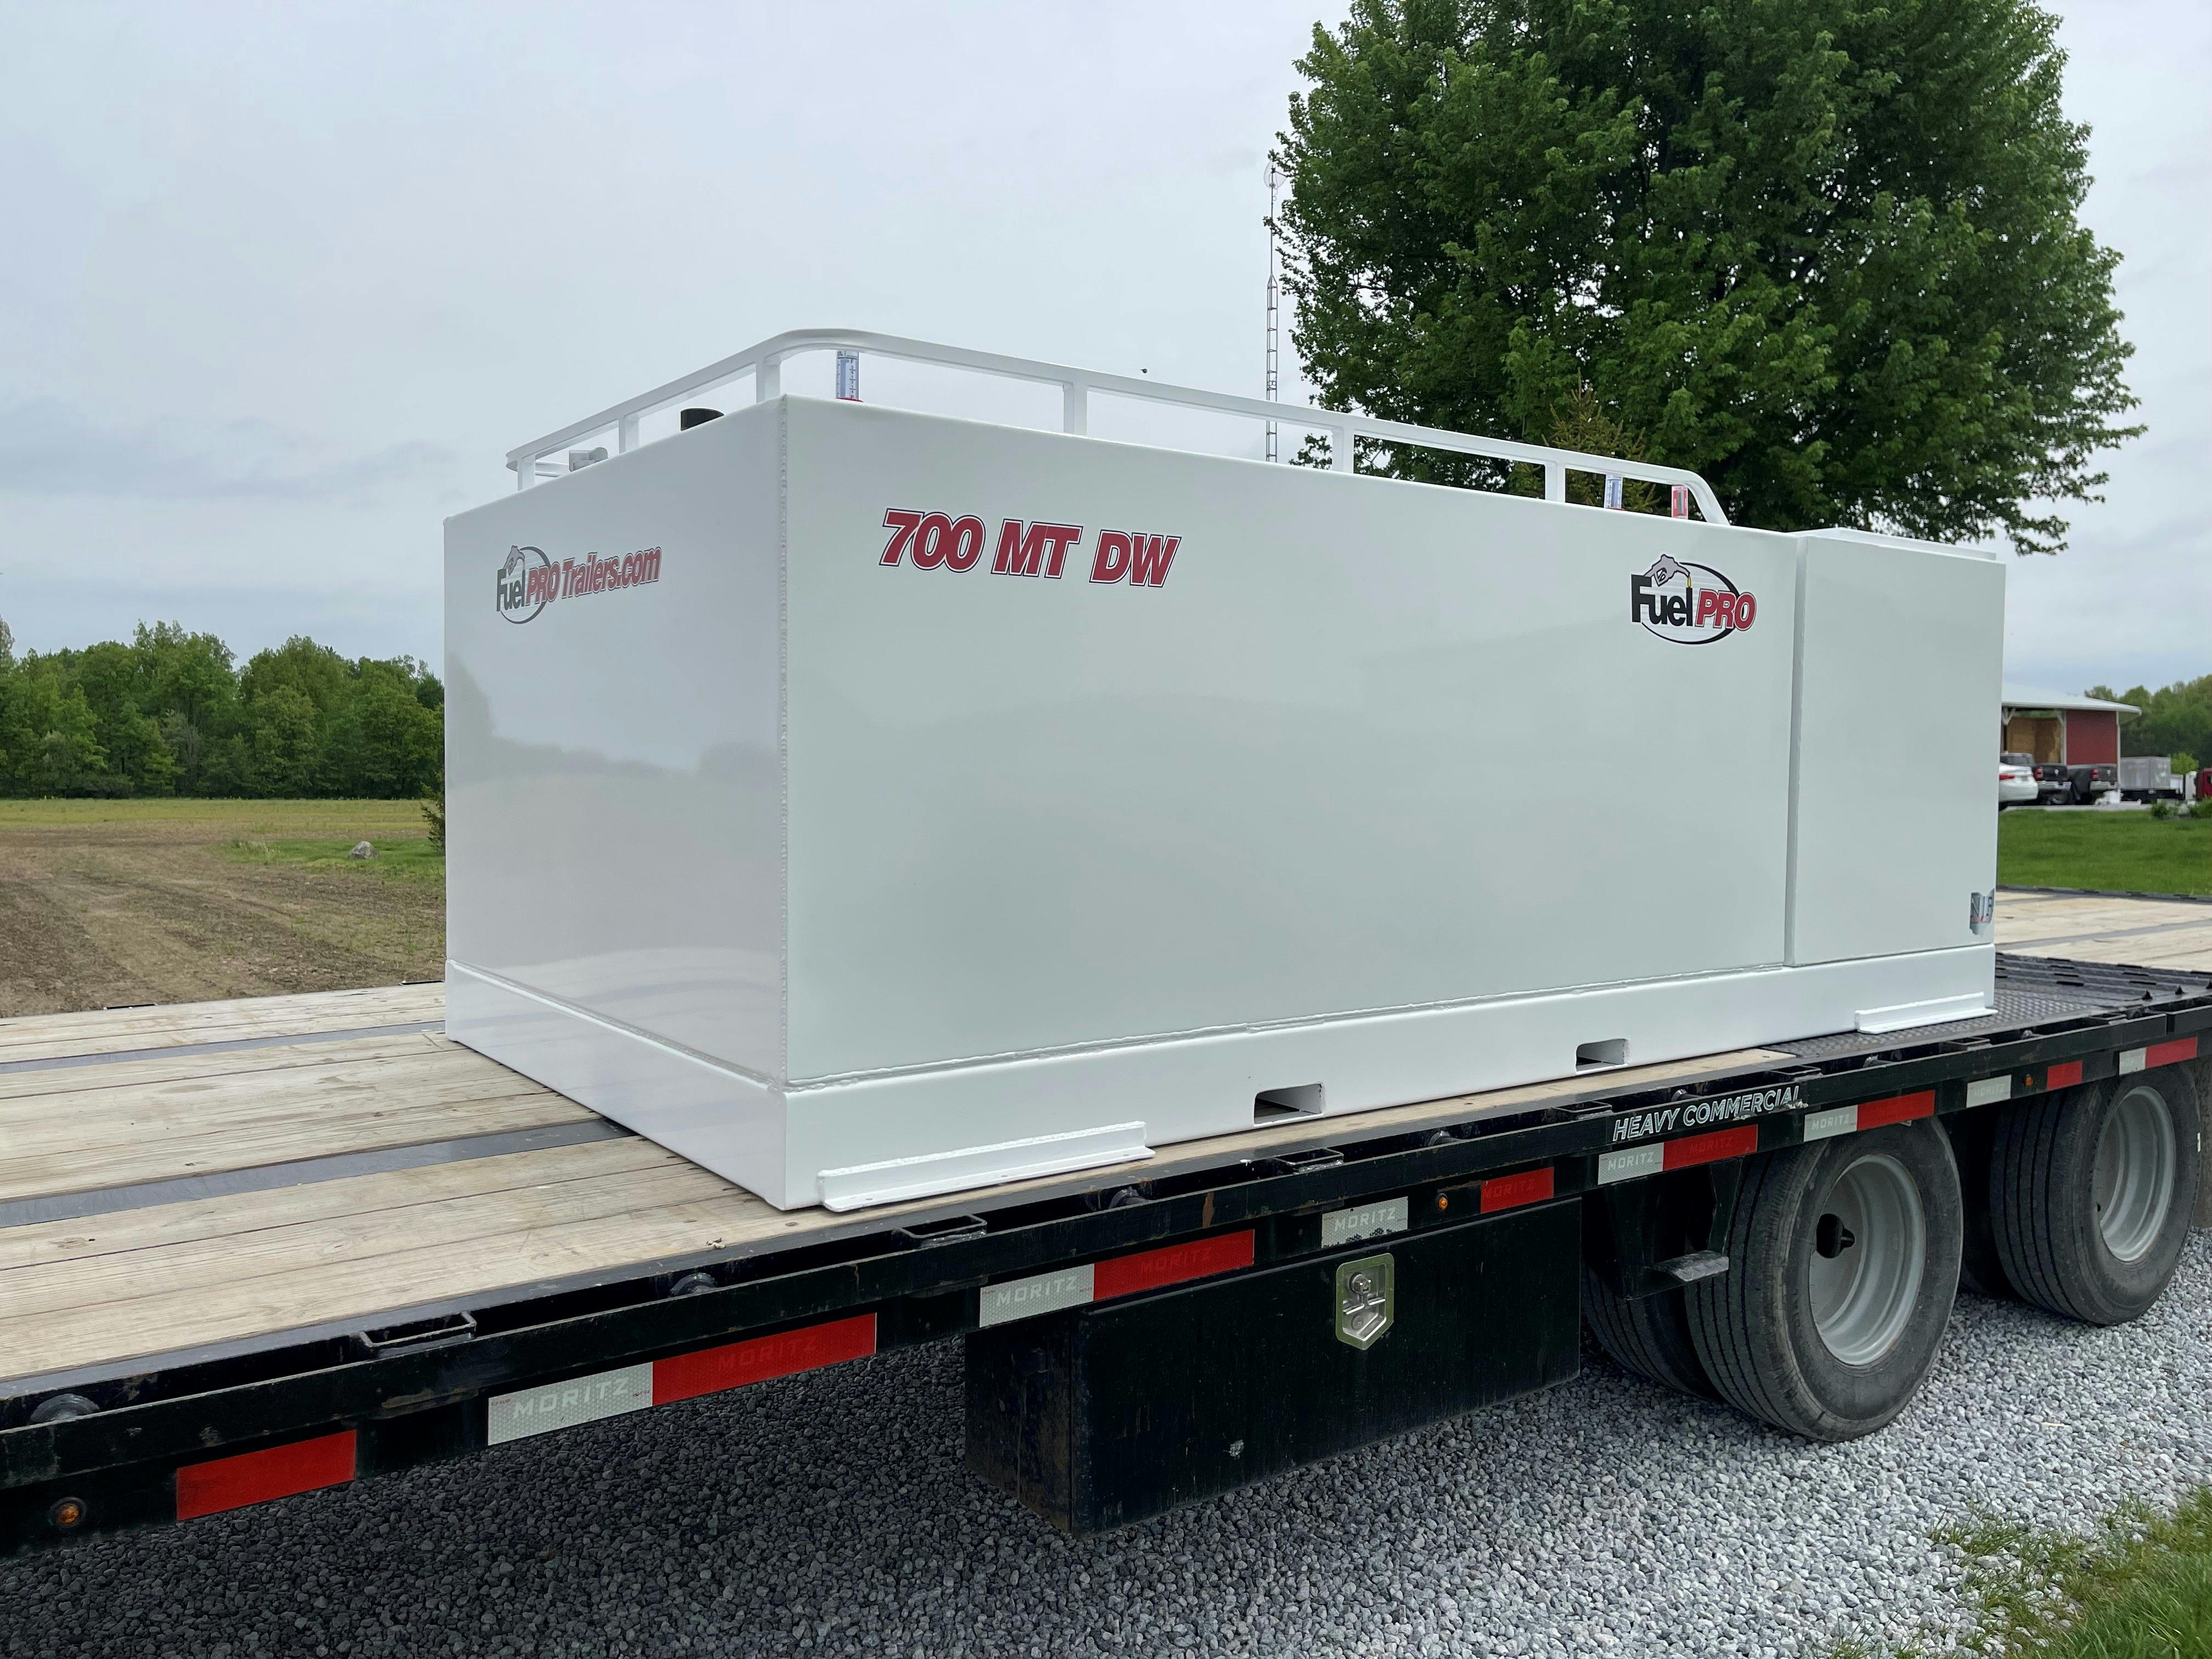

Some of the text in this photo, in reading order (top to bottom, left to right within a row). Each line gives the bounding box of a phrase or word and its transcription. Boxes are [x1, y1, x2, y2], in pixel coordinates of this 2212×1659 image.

[878, 507, 1182, 588] 700 MT DW
[561, 546, 662, 600] Trailers.com
[1612, 1107, 1681, 1142] HEAVY
[1812, 1114, 1850, 1131] MORITZ
[1607, 1153, 1655, 1171] MORITZ
[1334, 1207, 1396, 1232] MORITZ
[996, 1276, 1078, 1307] MORITZ
[512, 1377, 629, 1419] MORITZ
